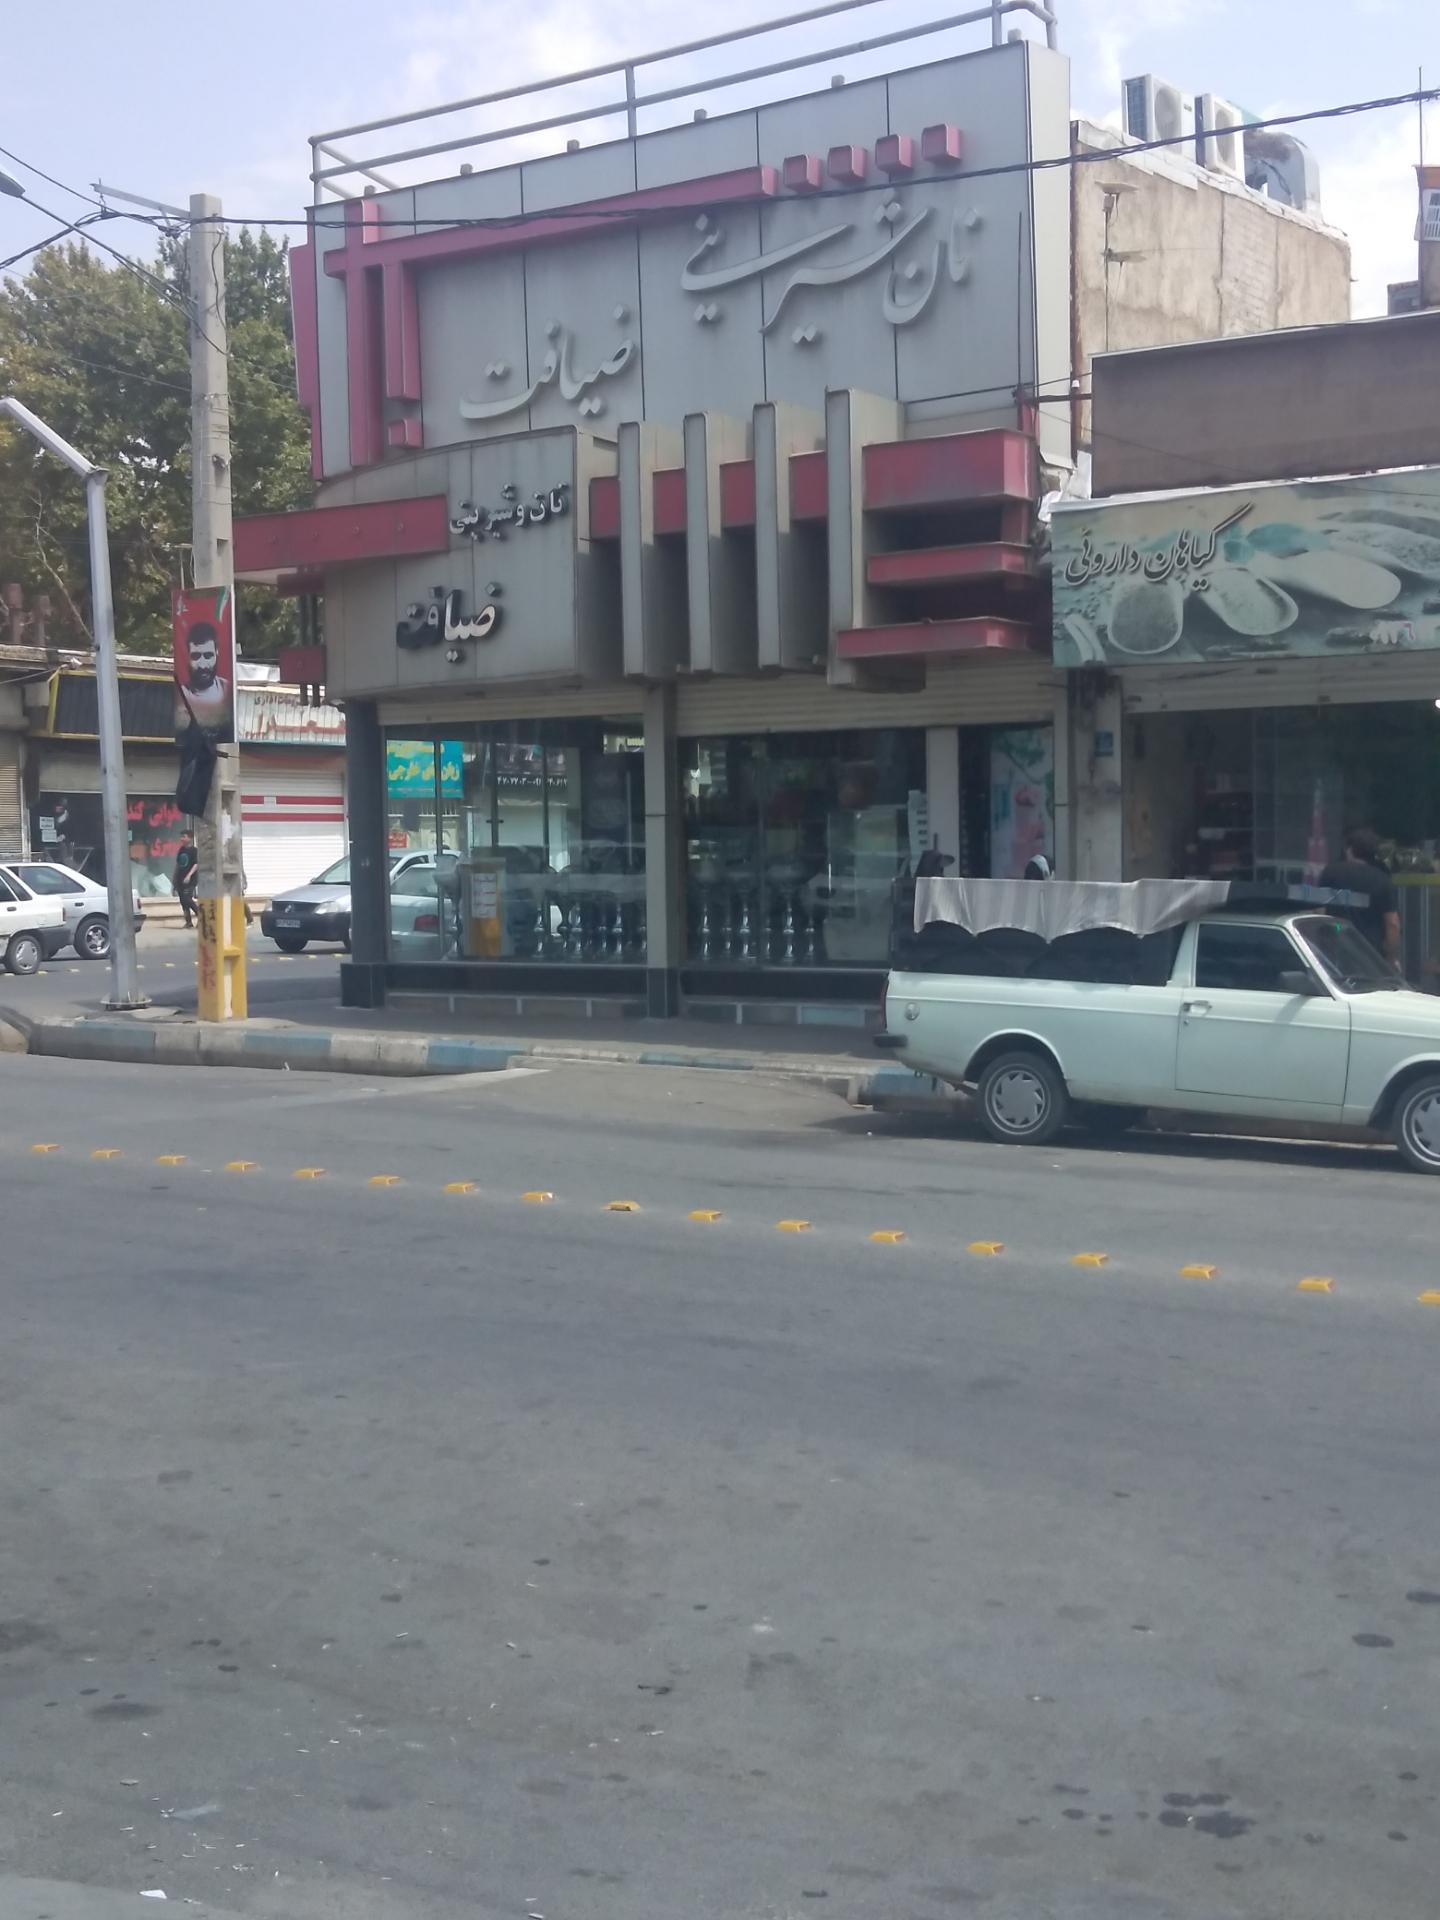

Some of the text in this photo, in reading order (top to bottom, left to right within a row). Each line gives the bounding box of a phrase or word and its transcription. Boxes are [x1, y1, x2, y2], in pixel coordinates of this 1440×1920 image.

[680, 188, 978, 345] نان شیرینی
[460, 305, 638, 420] ضیافت
[514, 503, 527, 527] و
[529, 482, 568, 522] نان
[1143, 502, 1254, 591] گیاهان
